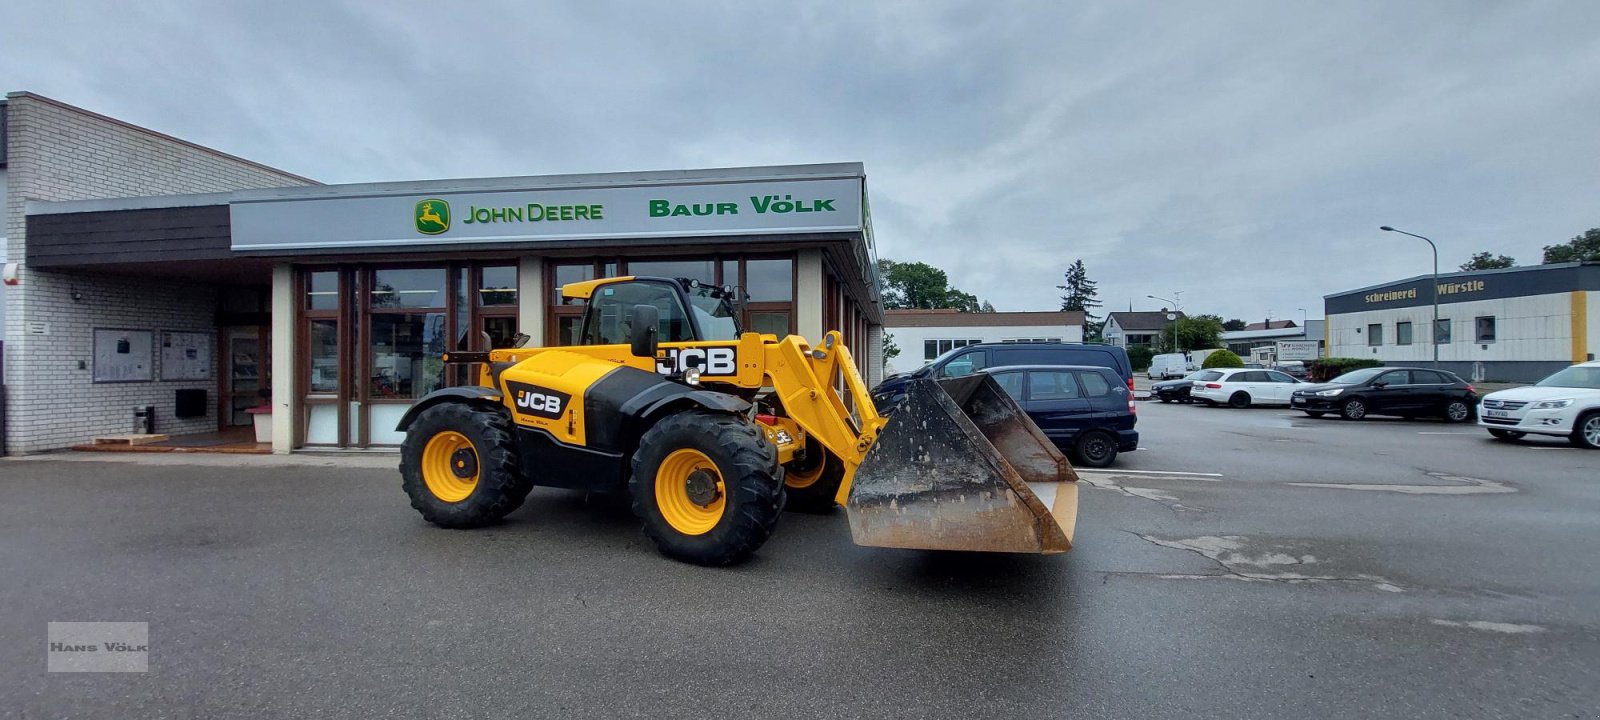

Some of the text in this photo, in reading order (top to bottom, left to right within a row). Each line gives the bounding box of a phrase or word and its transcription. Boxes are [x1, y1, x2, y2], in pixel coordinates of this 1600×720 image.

[463, 203, 604, 224] JOHN DEERE
[649, 194, 836, 218] BAUR VÖLK
[656, 348, 735, 375] JCB
[517, 391, 561, 413] JCB
